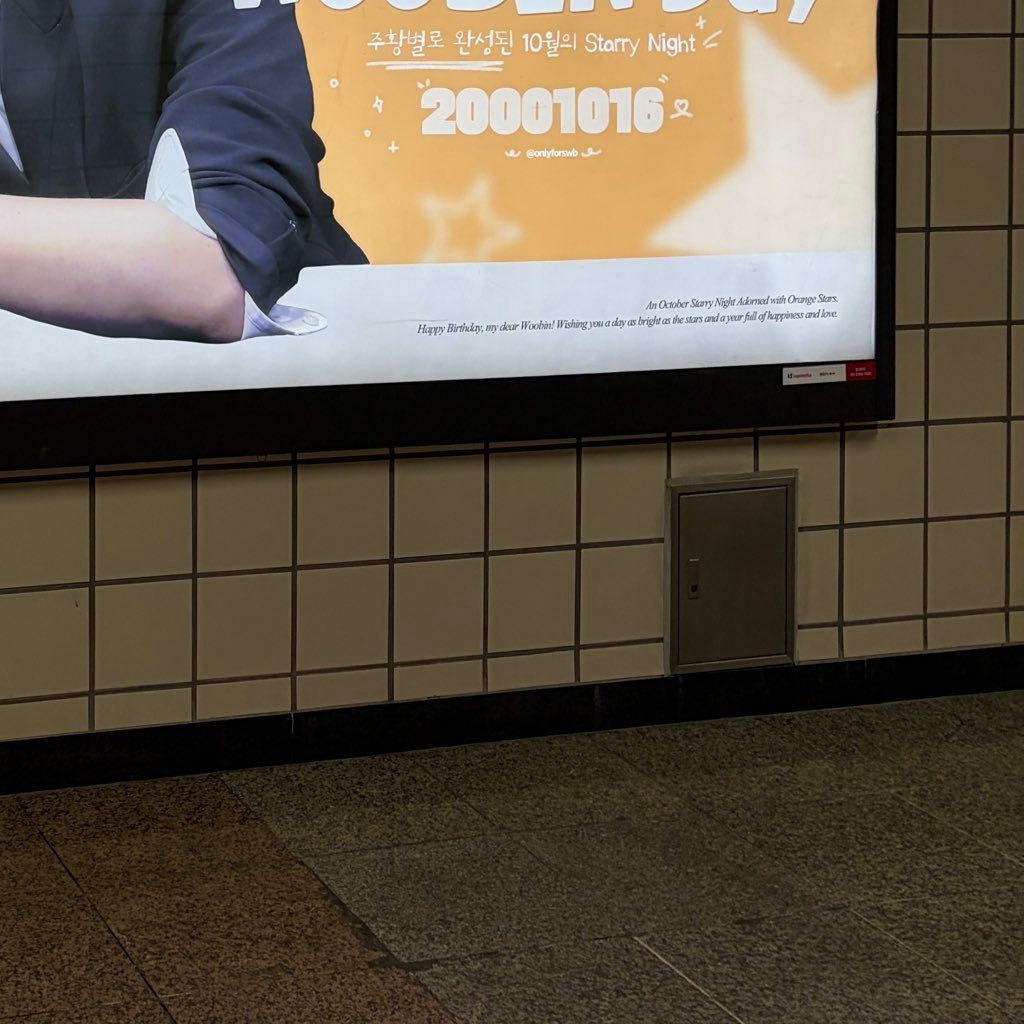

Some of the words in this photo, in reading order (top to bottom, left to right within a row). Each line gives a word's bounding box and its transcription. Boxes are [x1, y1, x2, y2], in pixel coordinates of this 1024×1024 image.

[367, 29, 445, 57] 주황별로
[453, 29, 513, 56] 완성된
[522, 30, 576, 57] 10월의
[584, 32, 640, 57] Starry
[648, 32, 696, 57] Night
[420, 86, 665, 135] 20001016
[526, 147, 579, 159] @onlyforswb
[645, 300, 657, 310] An
[658, 298, 689, 310] October
[690, 297, 713, 310] Starry
[715, 296, 736, 309] Night
[736, 296, 769, 307] Adorned
[770, 294, 786, 305] with
[787, 294, 816, 306] Orange
[417, 323, 445, 336] Happy
[446, 322, 484, 335] Birthday,
[485, 324, 499, 334] my
[500, 321, 519, 332] dear
[521, 319, 555, 331] Woobin!
[556, 318, 588, 331] Wishing
[588, 319, 604, 330] you
[604, 320, 611, 328] a
[611, 317, 626, 329] day
[627, 318, 637, 327] as
[638, 315, 661, 328] bright
[662, 317, 671, 325] as
[672, 314, 683, 325] the
[685, 315, 703, 324] stars
[704, 313, 720, 323] and
[720, 314, 726, 323] a
[726, 314, 744, 325] year
[743, 311, 757, 324] full
[758, 310, 769, 323] of
[767, 310, 804, 323] happiness
[805, 308, 821, 319] and
